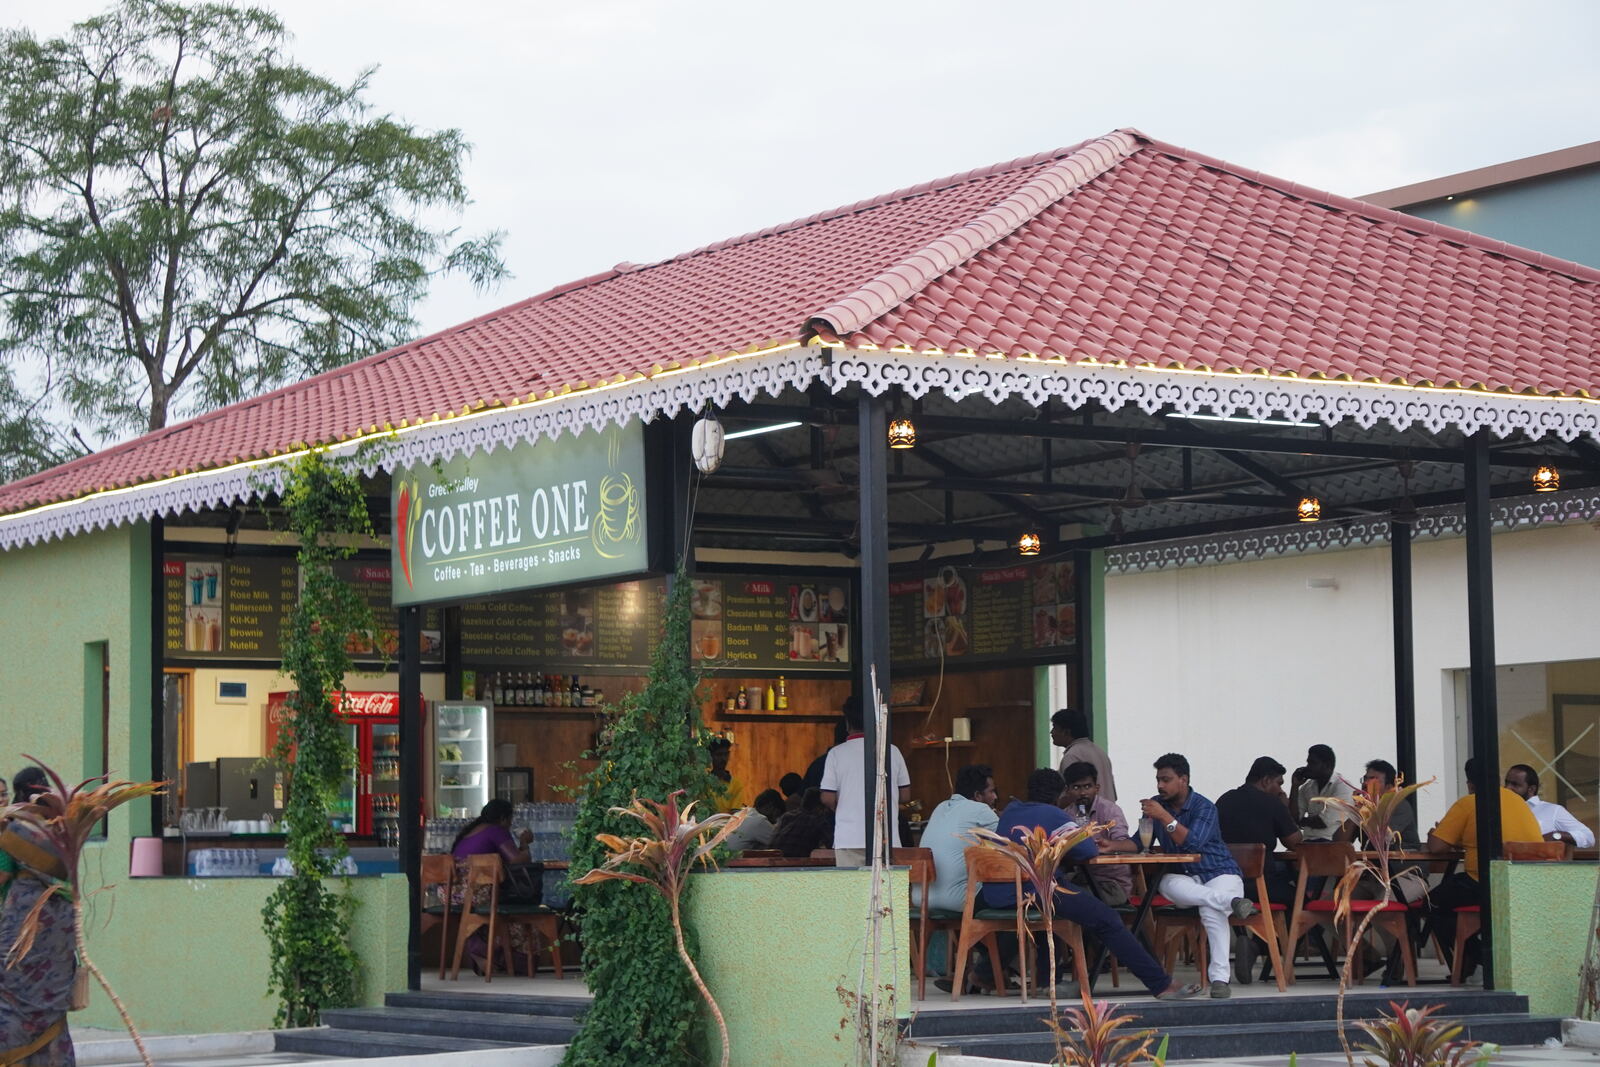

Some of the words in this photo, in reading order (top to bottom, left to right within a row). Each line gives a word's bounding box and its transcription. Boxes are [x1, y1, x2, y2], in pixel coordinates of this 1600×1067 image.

[421, 494, 521, 559] COFFEE
[531, 480, 589, 540] ONE
[434, 564, 461, 582] Coffee
[470, 562, 484, 576] Tea
[494, 551, 539, 572] Beverages
[548, 546, 581, 564] Snacks
[752, 584, 771, 593] Milk
[230, 592, 251, 600] Rose
[253, 592, 270, 600] Milk
[230, 604, 273, 613] Butterscotch
[727, 624, 752, 632] Badam
[754, 624, 769, 632] Milk
[230, 629, 264, 638] Brownie
[230, 642, 258, 650] Nutella
[727, 637, 750, 646] Boost
[727, 651, 758, 660] Horlicks
